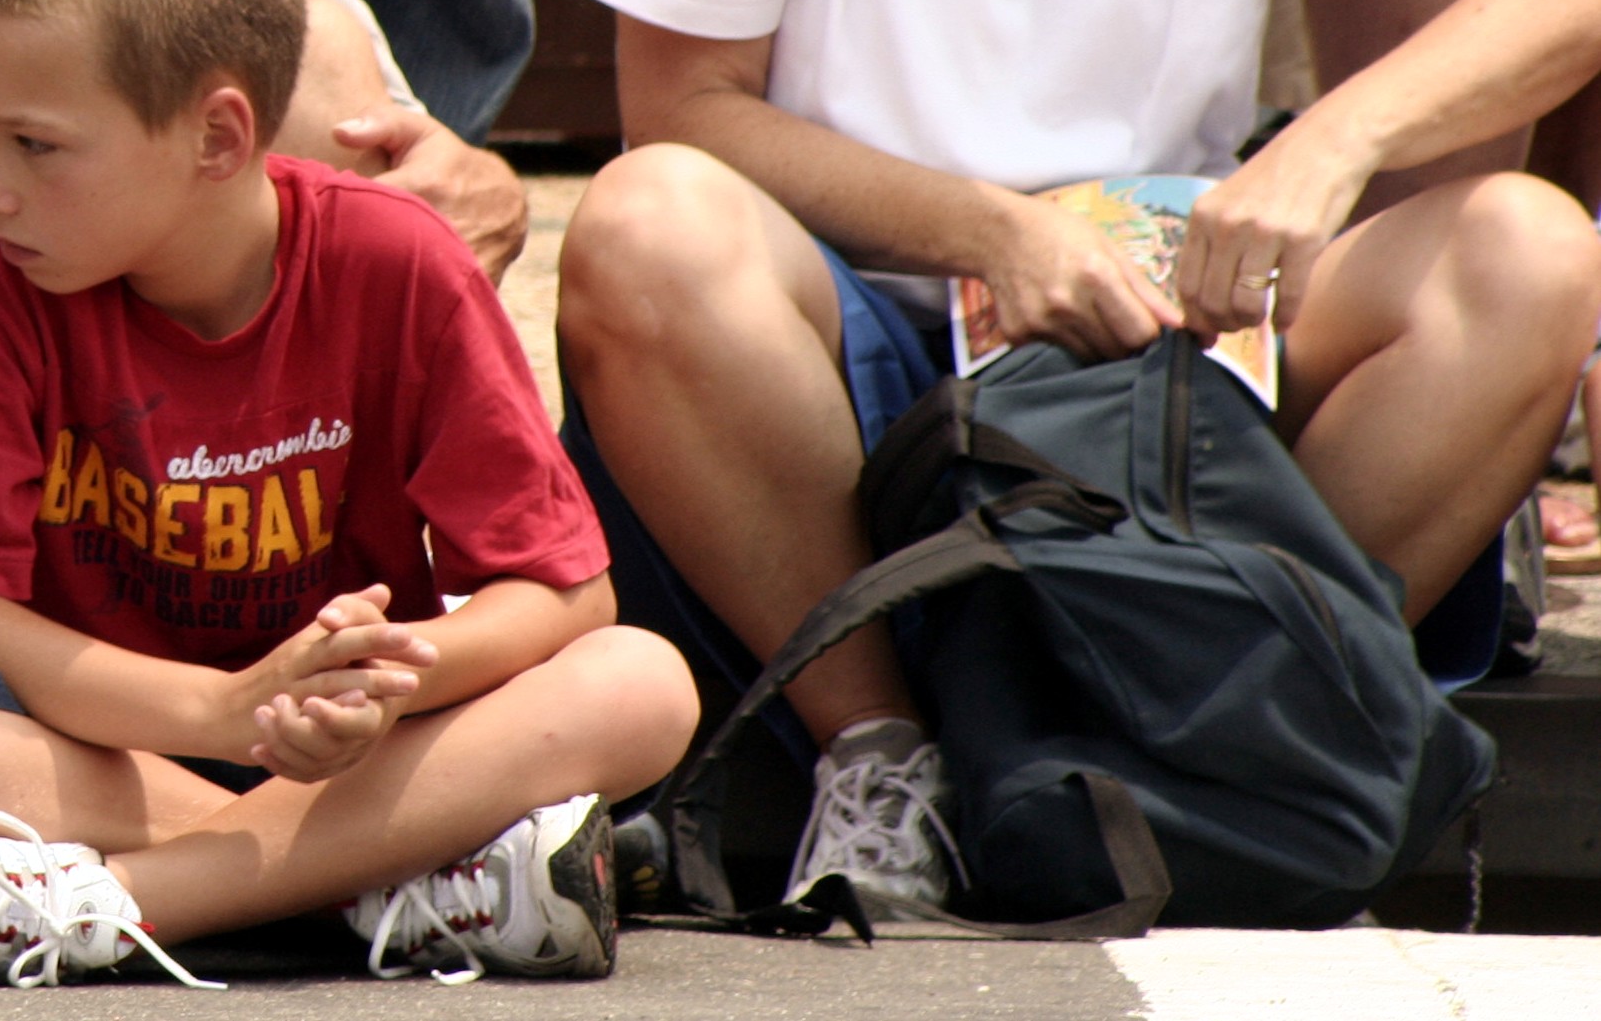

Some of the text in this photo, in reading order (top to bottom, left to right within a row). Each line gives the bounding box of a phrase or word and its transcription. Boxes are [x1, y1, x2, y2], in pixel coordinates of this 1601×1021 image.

[167, 417, 353, 481] abercrombie
[115, 571, 301, 631] TO BACK UP
